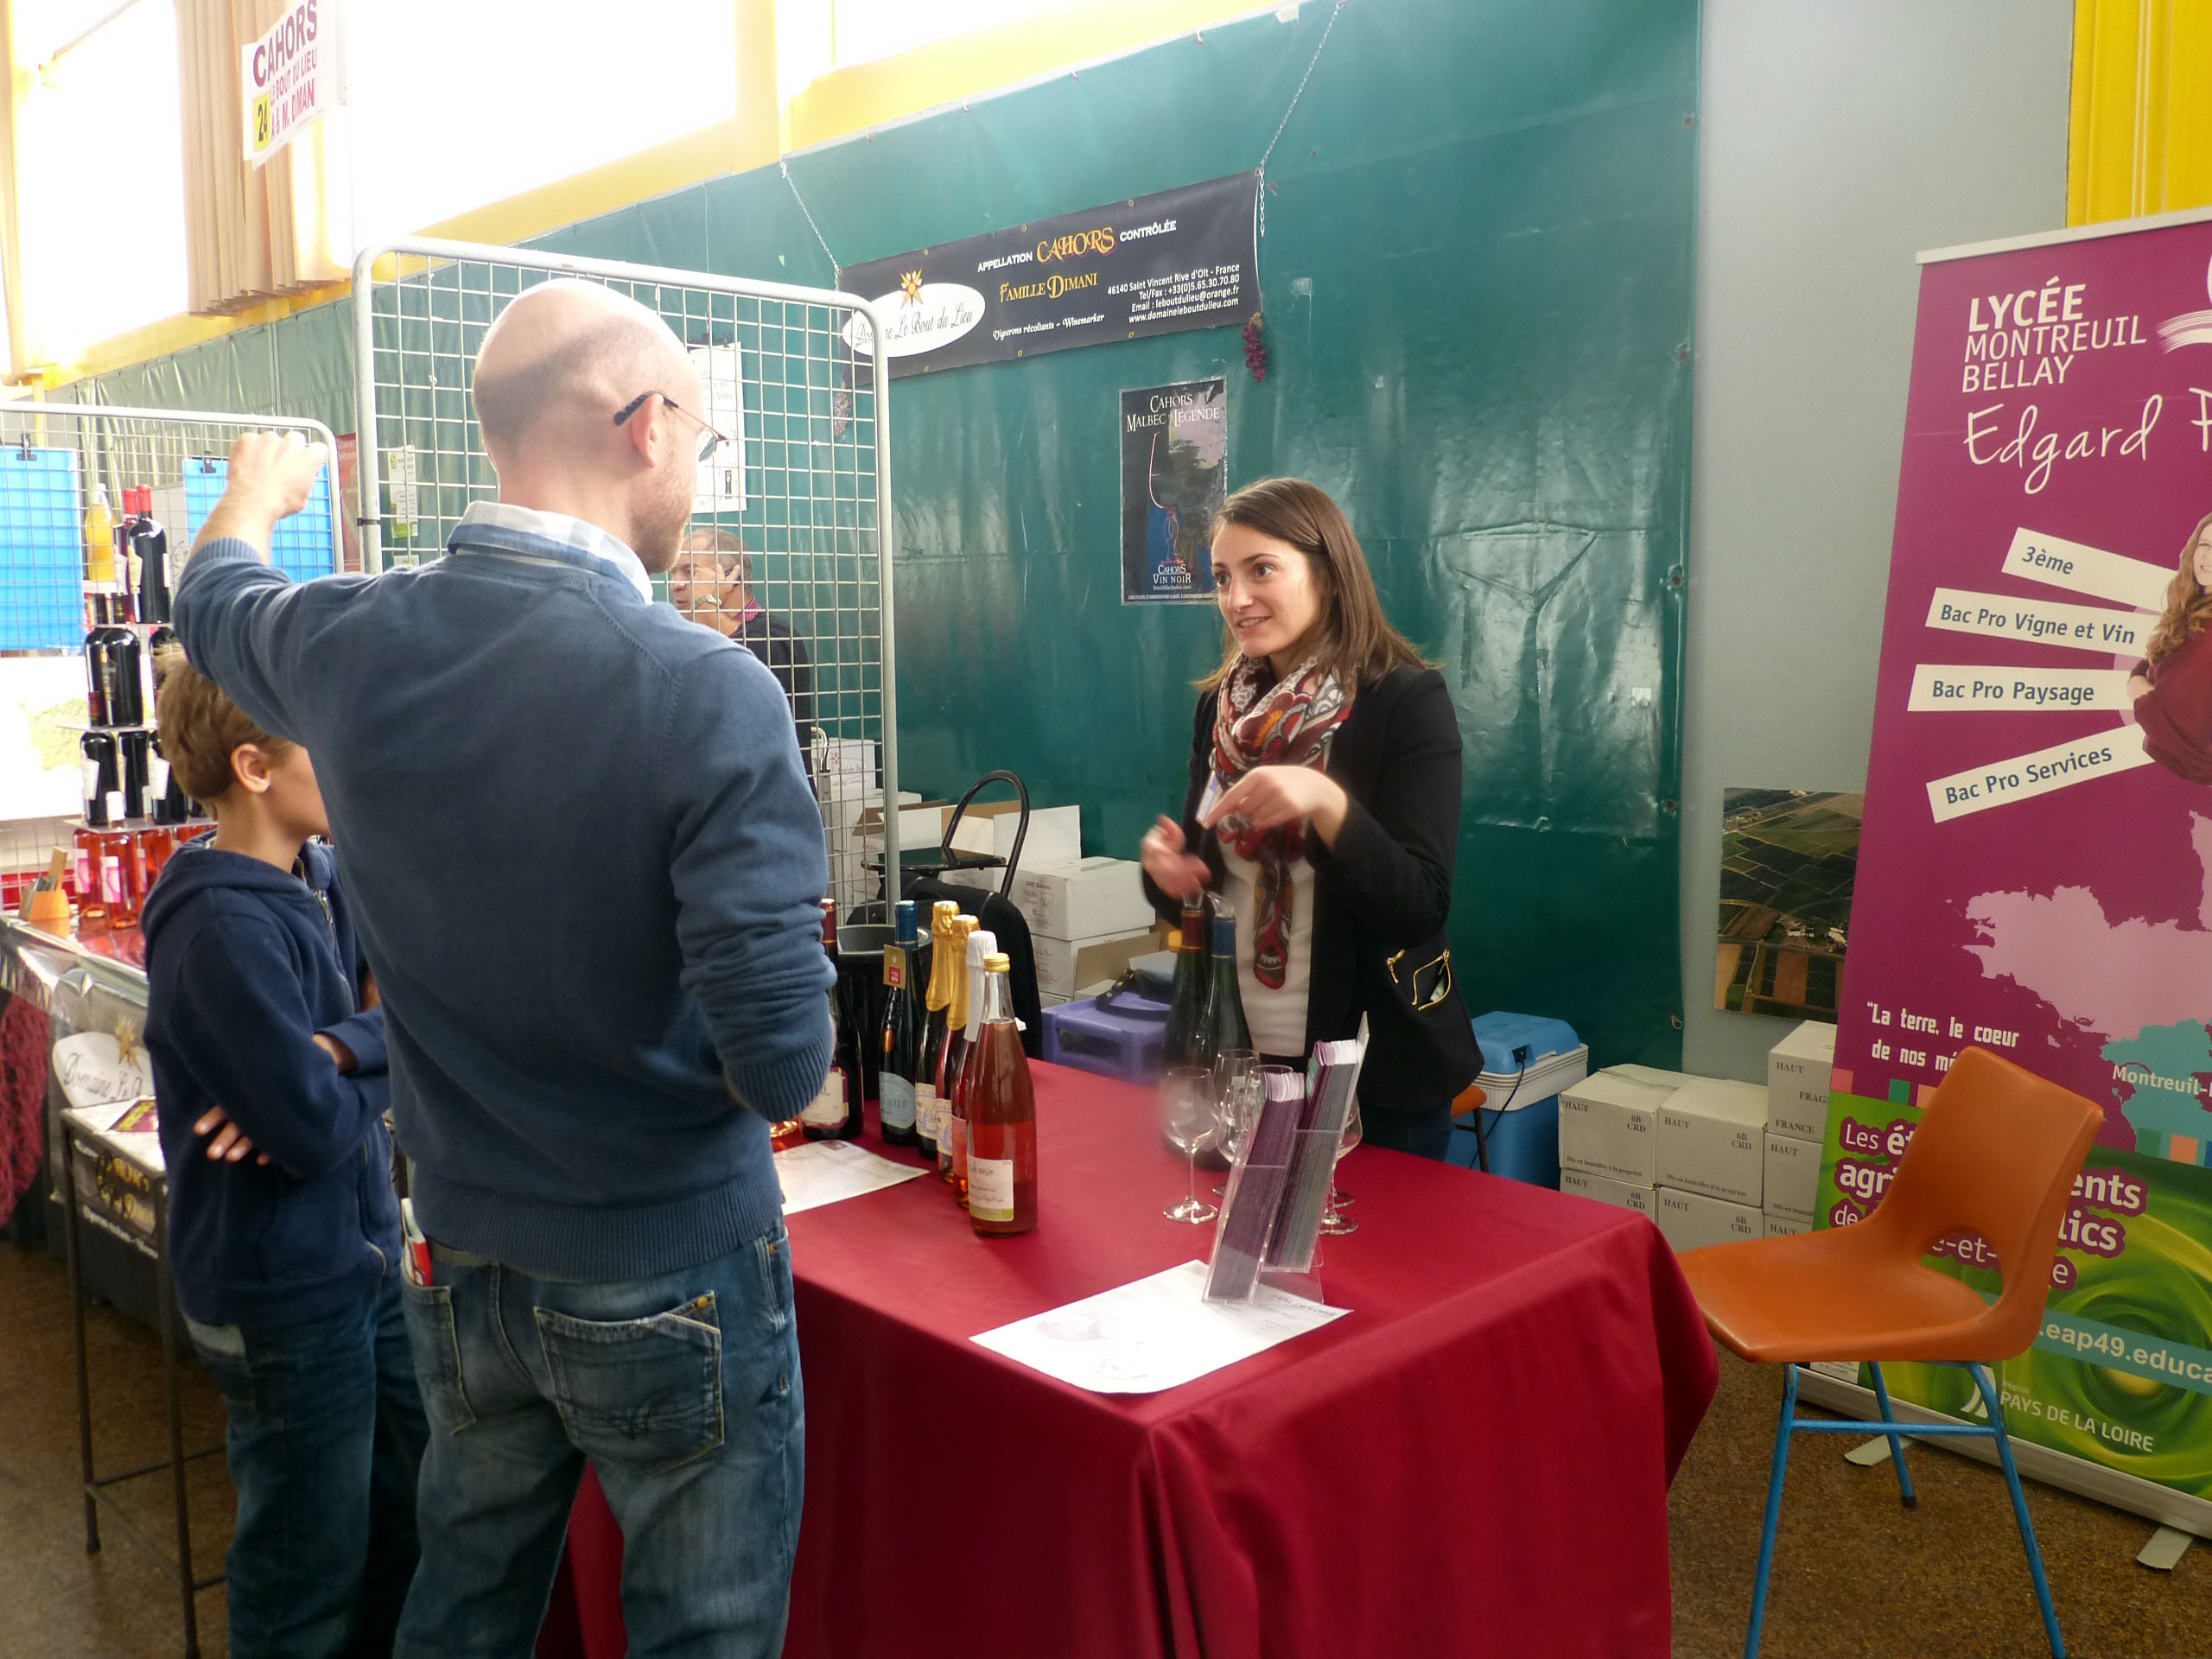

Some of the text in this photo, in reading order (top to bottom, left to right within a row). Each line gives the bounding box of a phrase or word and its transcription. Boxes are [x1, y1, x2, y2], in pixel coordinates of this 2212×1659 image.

[253, 0, 317, 87] CAHORS
[276, 69, 291, 100] BOUT
[302, 47, 317, 78] LIEU
[257, 101, 268, 143] 24
[977, 219, 1177, 272] APPELLATION CAHORS CONTRÔLÉE
[999, 272, 1097, 302] FAMILLE DIMANI
[1107, 283, 1128, 296] 46140
[1129, 280, 1146, 292] Saint
[1147, 275, 1173, 288] Vincent
[1174, 272, 1189, 283] Rive
[1216, 264, 1240, 275] France
[1139, 289, 1163, 301] Tel/Fax
[1168, 274, 1240, 295] +33(0)5.65.30.70.80
[1128, 298, 1238, 323] www.domaineleboutdulieu.com
[1132, 302, 1150, 313] Email
[1156, 285, 1240, 308] leboutdulieu@orange.fr
[1968, 276, 2086, 332] LYCÉE
[895, 315, 908, 340] Le
[911, 311, 934, 335] Bout
[937, 306, 949, 329] du
[950, 302, 974, 328] Lieu
[1063, 314, 1104, 328] Winemarker
[1964, 315, 2147, 363] MONTREUIL
[1962, 354, 2075, 393] BELLAY
[1149, 394, 1193, 414] CAHORS
[1127, 407, 1221, 433] MALBEC LEGENDE
[1963, 394, 2164, 494] Edgard
[1158, 563, 1186, 575] CAHORS
[2022, 545, 2074, 575] 3ème
[1153, 573, 1192, 584] VIN NOIR
[1940, 604, 2135, 645] Bac Pro Vigne et Vin
[1932, 680, 2094, 705] Bac Pro Paysage
[1945, 746, 2113, 804] Bac Pro Services
[1948, 1016, 1963, 1039] le
[1974, 1026, 2019, 1048] coeur
[1872, 1039, 1891, 1060] de
[1899, 1047, 1927, 1067] nos
[1776, 1062, 1804, 1074] HAUT
[2113, 1065, 2212, 1097] Montreuil-
[1565, 1101, 1589, 1112] HAUT
[1627, 1122, 1646, 1133] CRD
[1664, 1117, 1690, 1129] HAUT
[1776, 1119, 1815, 1135] FRANCE
[1846, 1123, 1878, 1149] Les
[1732, 1140, 1752, 1151] CRD
[1770, 1144, 1798, 1156] HAUT
[1565, 1175, 1588, 1188] HAUT
[1840, 1164, 1899, 1198] agr
[1626, 1199, 1645, 1209] CRD
[1664, 1198, 1690, 1211] HAUT
[1731, 1224, 1751, 1235] CRD
[1770, 1224, 1797, 1236] HAUT
[2000, 1391, 2154, 1452] PAYS DE LA LOIRE
